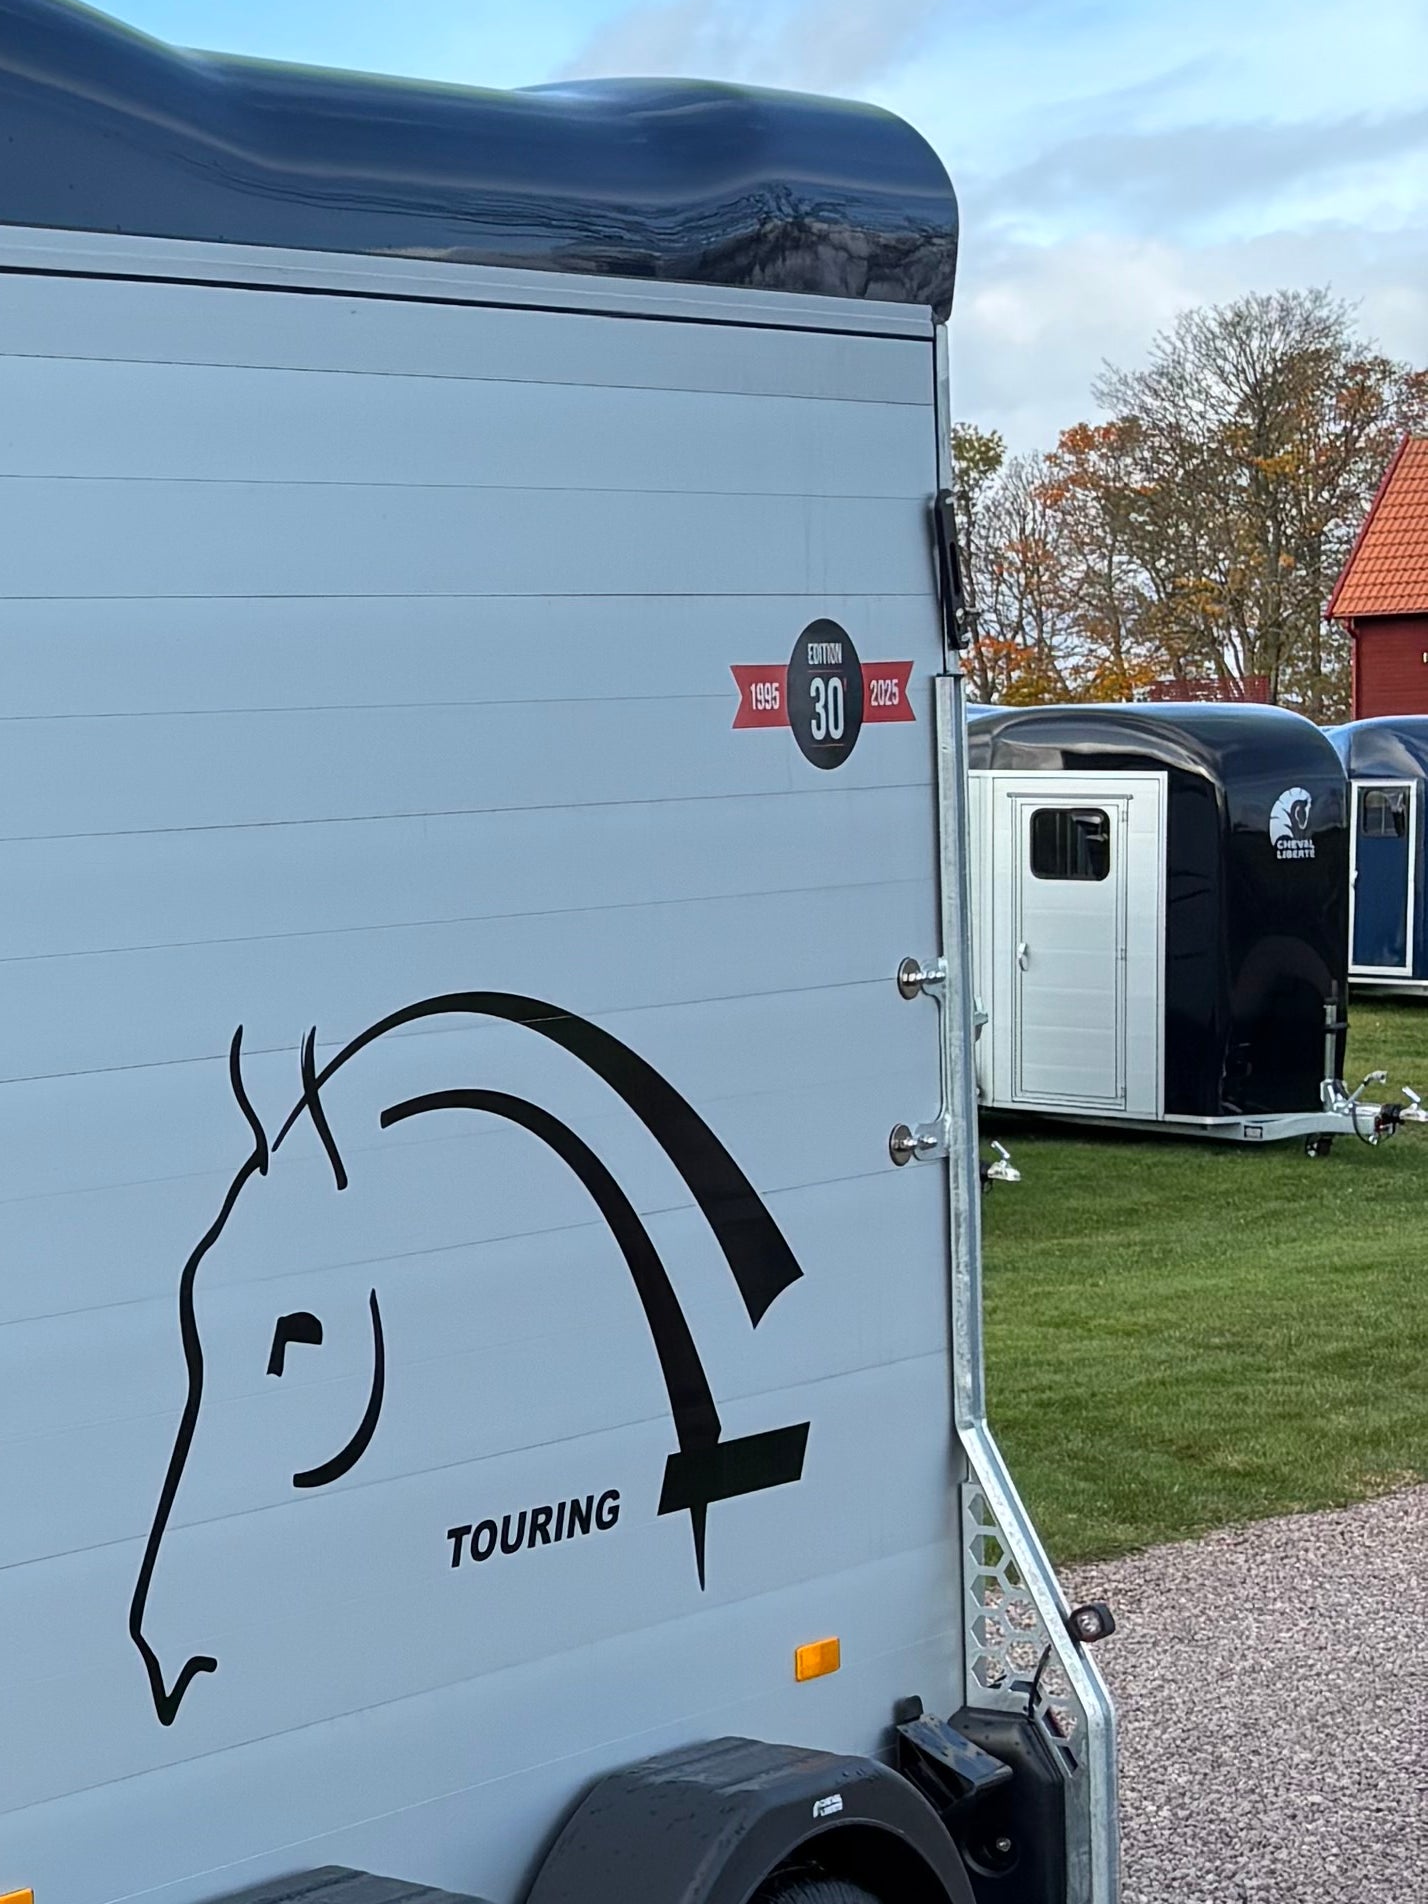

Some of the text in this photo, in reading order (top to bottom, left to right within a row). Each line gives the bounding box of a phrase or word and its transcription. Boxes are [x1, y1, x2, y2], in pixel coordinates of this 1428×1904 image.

[807, 643, 843, 665] EDITION
[750, 682, 780, 710] 1995
[870, 679, 900, 707] 2025
[809, 676, 845, 741] 30
[1276, 839, 1315, 850] CHEVAL
[446, 1488, 621, 1569] TOURING
